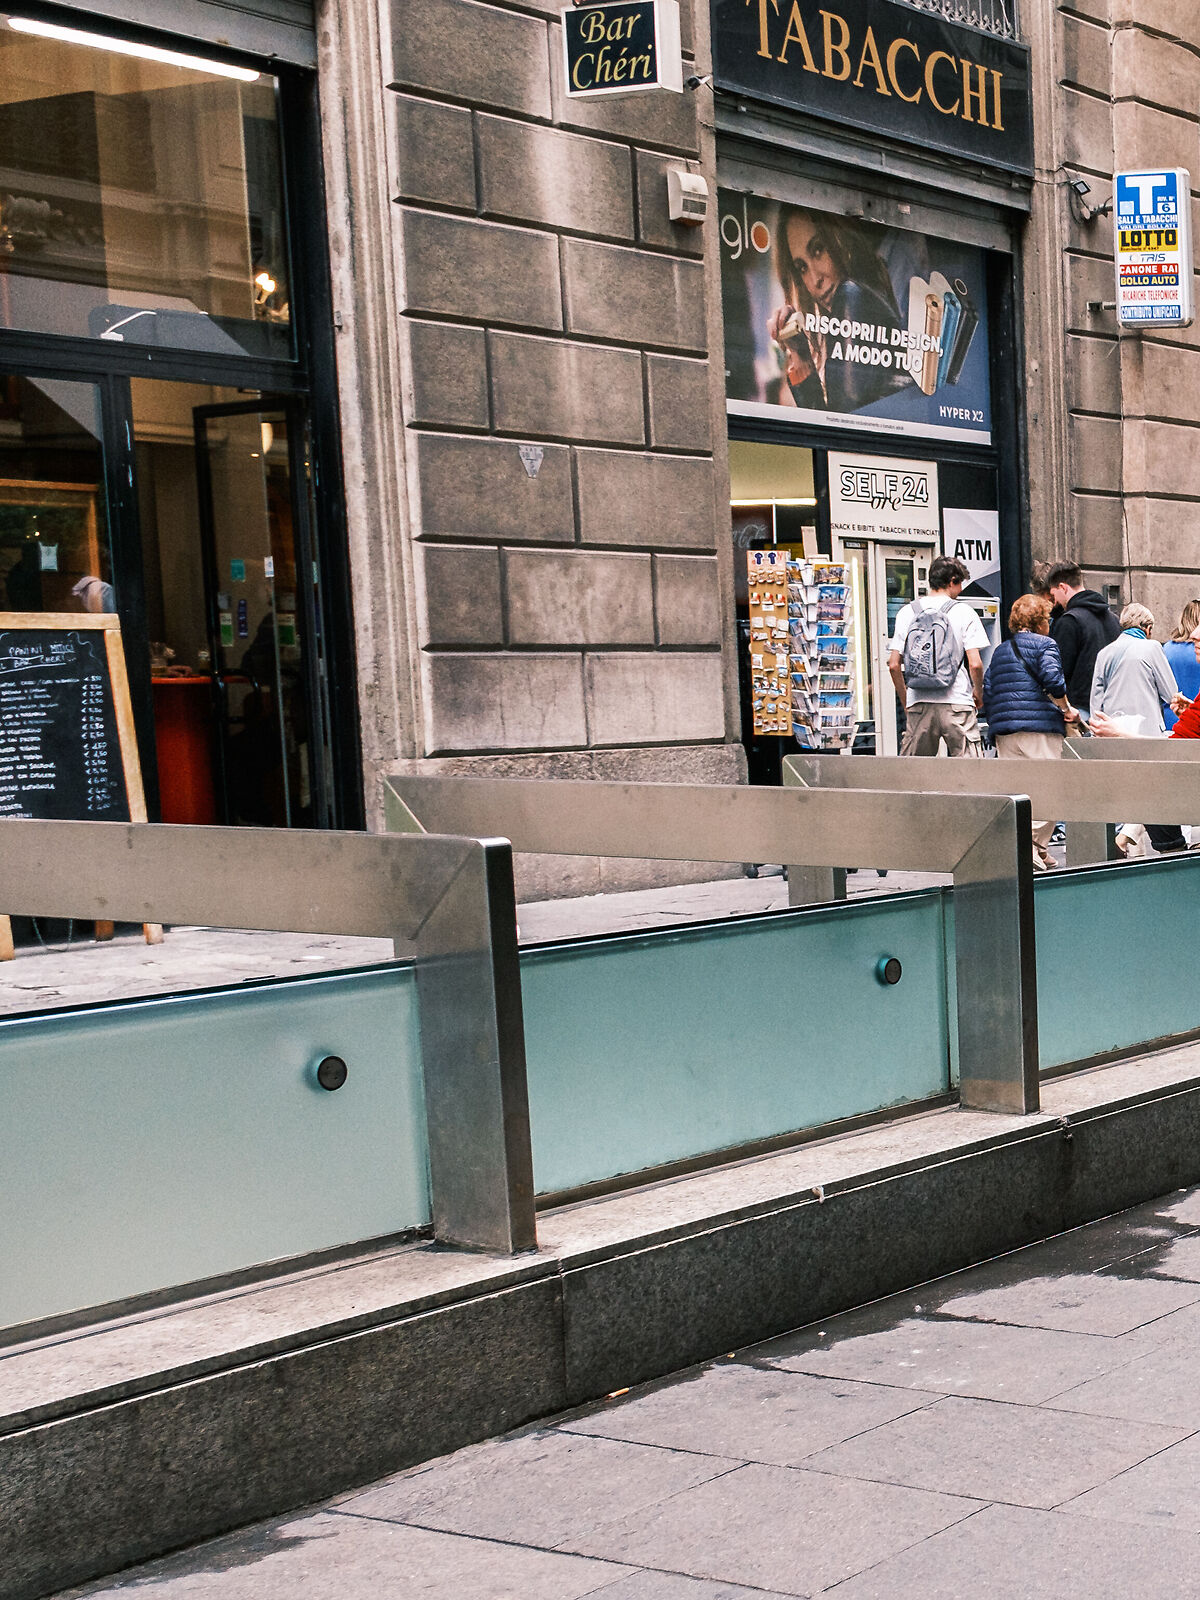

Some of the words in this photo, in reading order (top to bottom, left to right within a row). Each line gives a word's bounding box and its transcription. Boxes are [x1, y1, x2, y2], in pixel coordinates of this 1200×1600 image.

[580, 10, 642, 44] Bar
[572, 44, 653, 90] Chéri
[745, 0, 1005, 131] TABACCHI
[1161, 203, 1171, 213] 6
[720, 196, 771, 260] glo
[1118, 215, 1134, 224] SALI
[1135, 215, 1142, 224] E
[1142, 214, 1178, 224] TABACCHI
[1121, 229, 1177, 247] LOTTO
[1140, 253, 1166, 262] TRIS
[1120, 265, 1158, 274] CANONE
[1161, 264, 1178, 273] RAI
[1120, 276, 1150, 286] BOLLO
[1151, 276, 1177, 285] AUTO
[804, 313, 875, 343] RISCOPRI
[876, 325, 889, 345] IL
[890, 328, 944, 358] DESIGN,
[831, 341, 844, 360] A
[844, 343, 892, 368] MODO
[894, 351, 923, 373] TUO
[939, 405, 971, 421] HYPER
[971, 409, 984, 423] X2
[840, 470, 899, 500] SELF
[901, 476, 929, 503] 24
[871, 496, 902, 512] ore
[831, 523, 851, 531] SNACK
[851, 523, 856, 531] E
[857, 524, 876, 533] BIBITE
[879, 525, 907, 535] TABACCHI
[908, 527, 912, 535] E
[954, 538, 992, 561] ATM
[8, 643, 43, 657] PANINI
